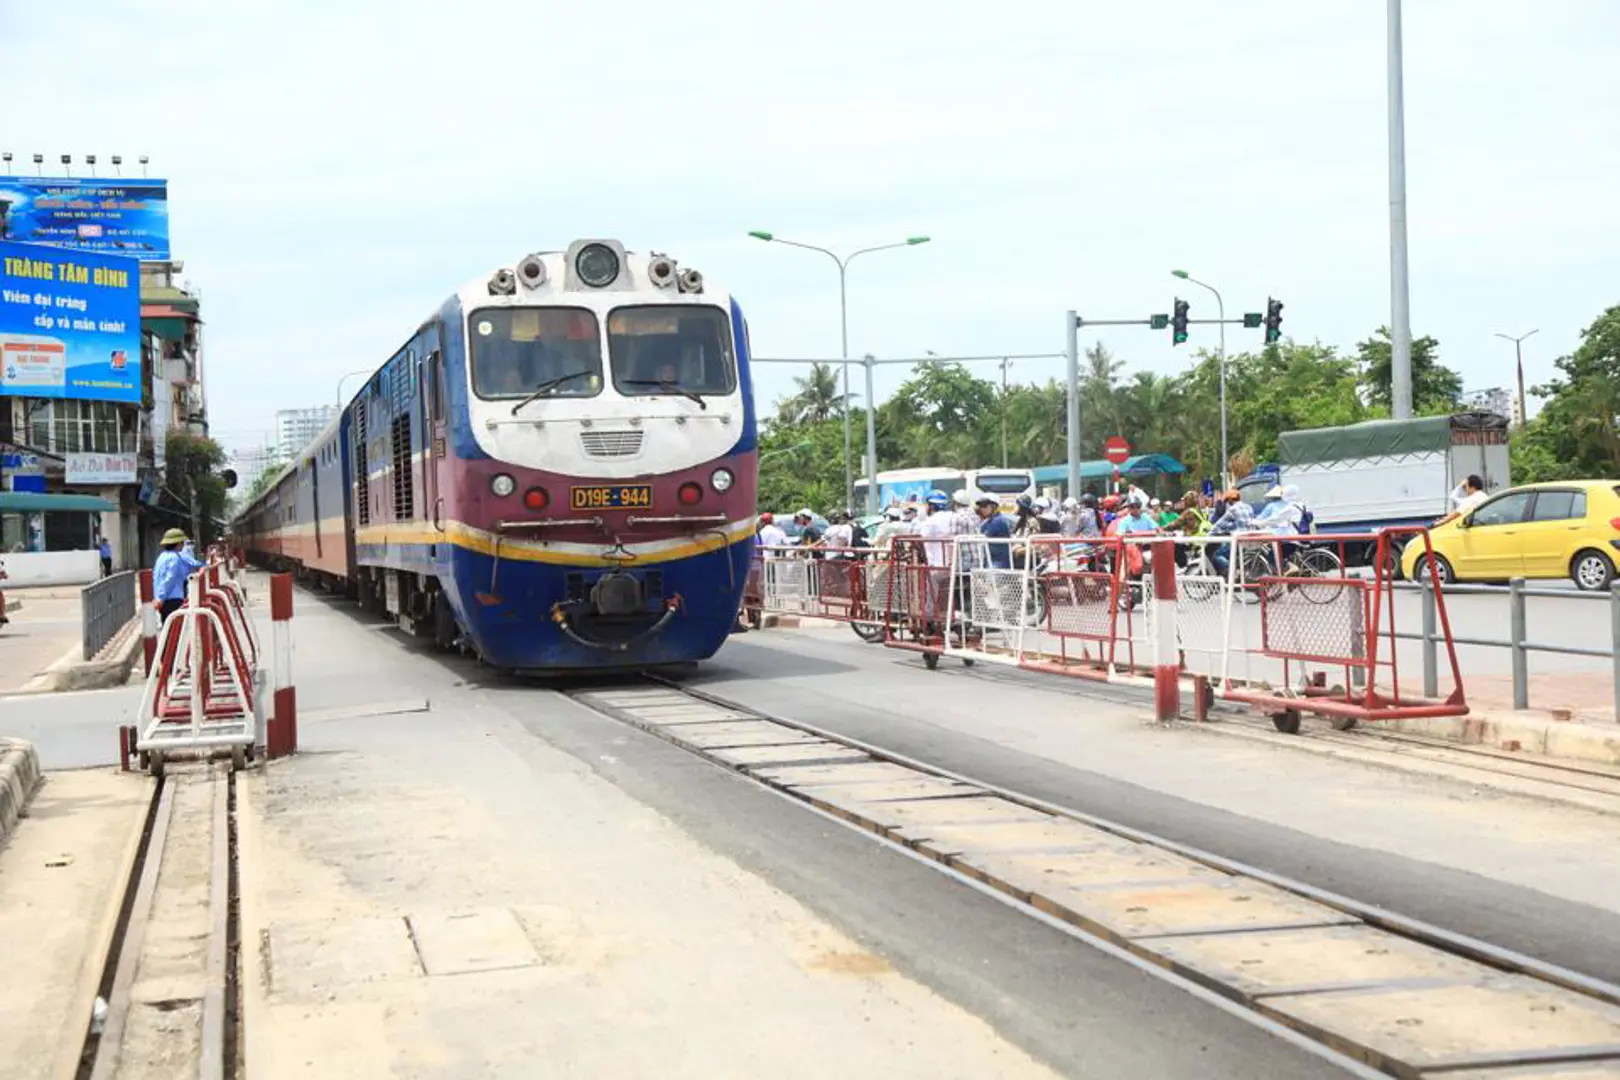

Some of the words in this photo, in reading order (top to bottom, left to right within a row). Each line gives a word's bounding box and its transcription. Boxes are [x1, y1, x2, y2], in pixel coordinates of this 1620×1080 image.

[4, 256, 54, 280] TRÀNG
[58, 262, 88, 284] TÂM
[94, 266, 129, 288] BÌNH
[57, 315, 70, 329] và
